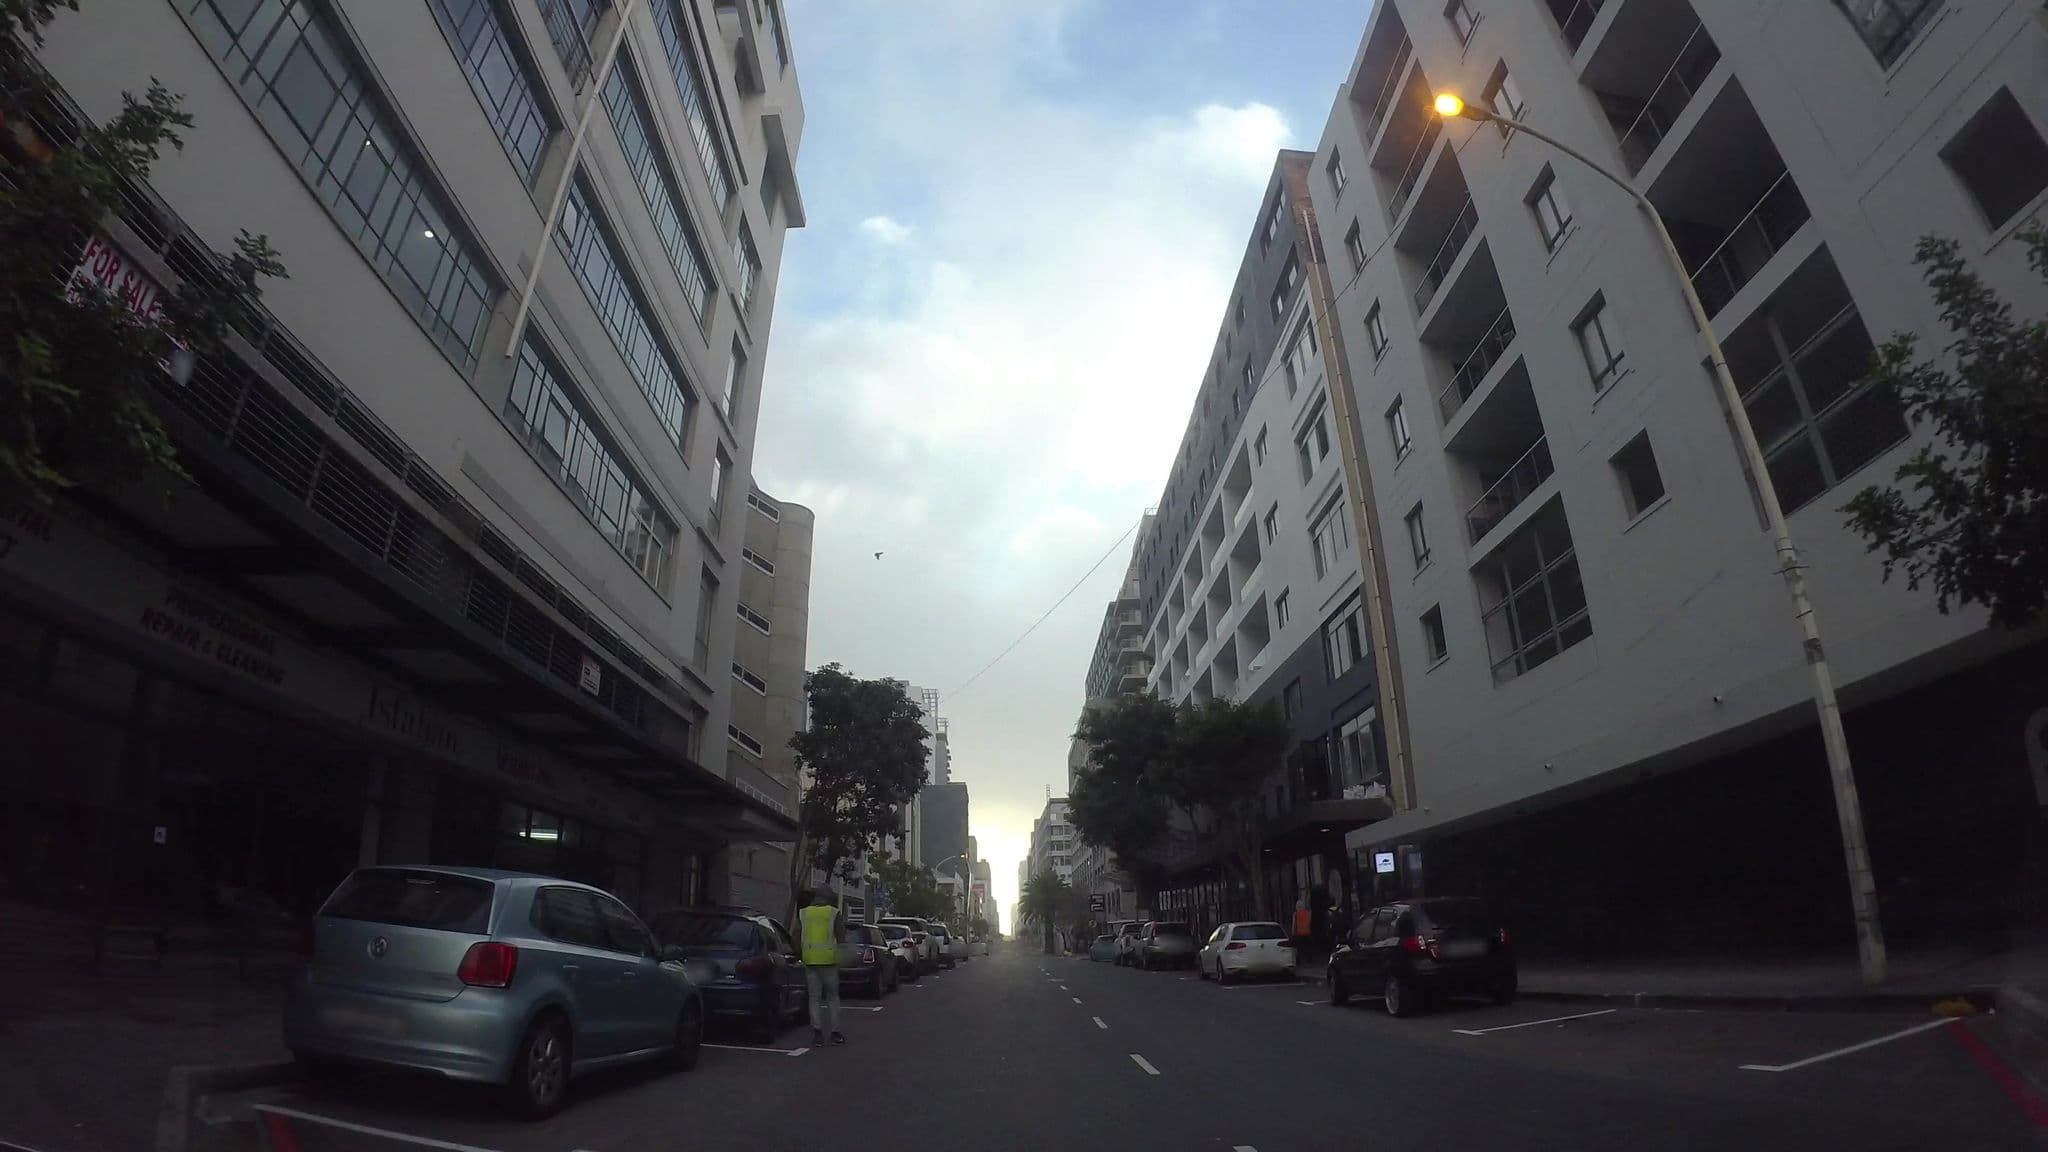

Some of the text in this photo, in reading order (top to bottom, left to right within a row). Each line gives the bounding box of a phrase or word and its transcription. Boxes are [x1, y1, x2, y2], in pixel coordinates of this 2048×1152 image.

[81, 238, 122, 289] FOR
[122, 270, 162, 322] SALE
[140, 606, 200, 652] REPAIR
